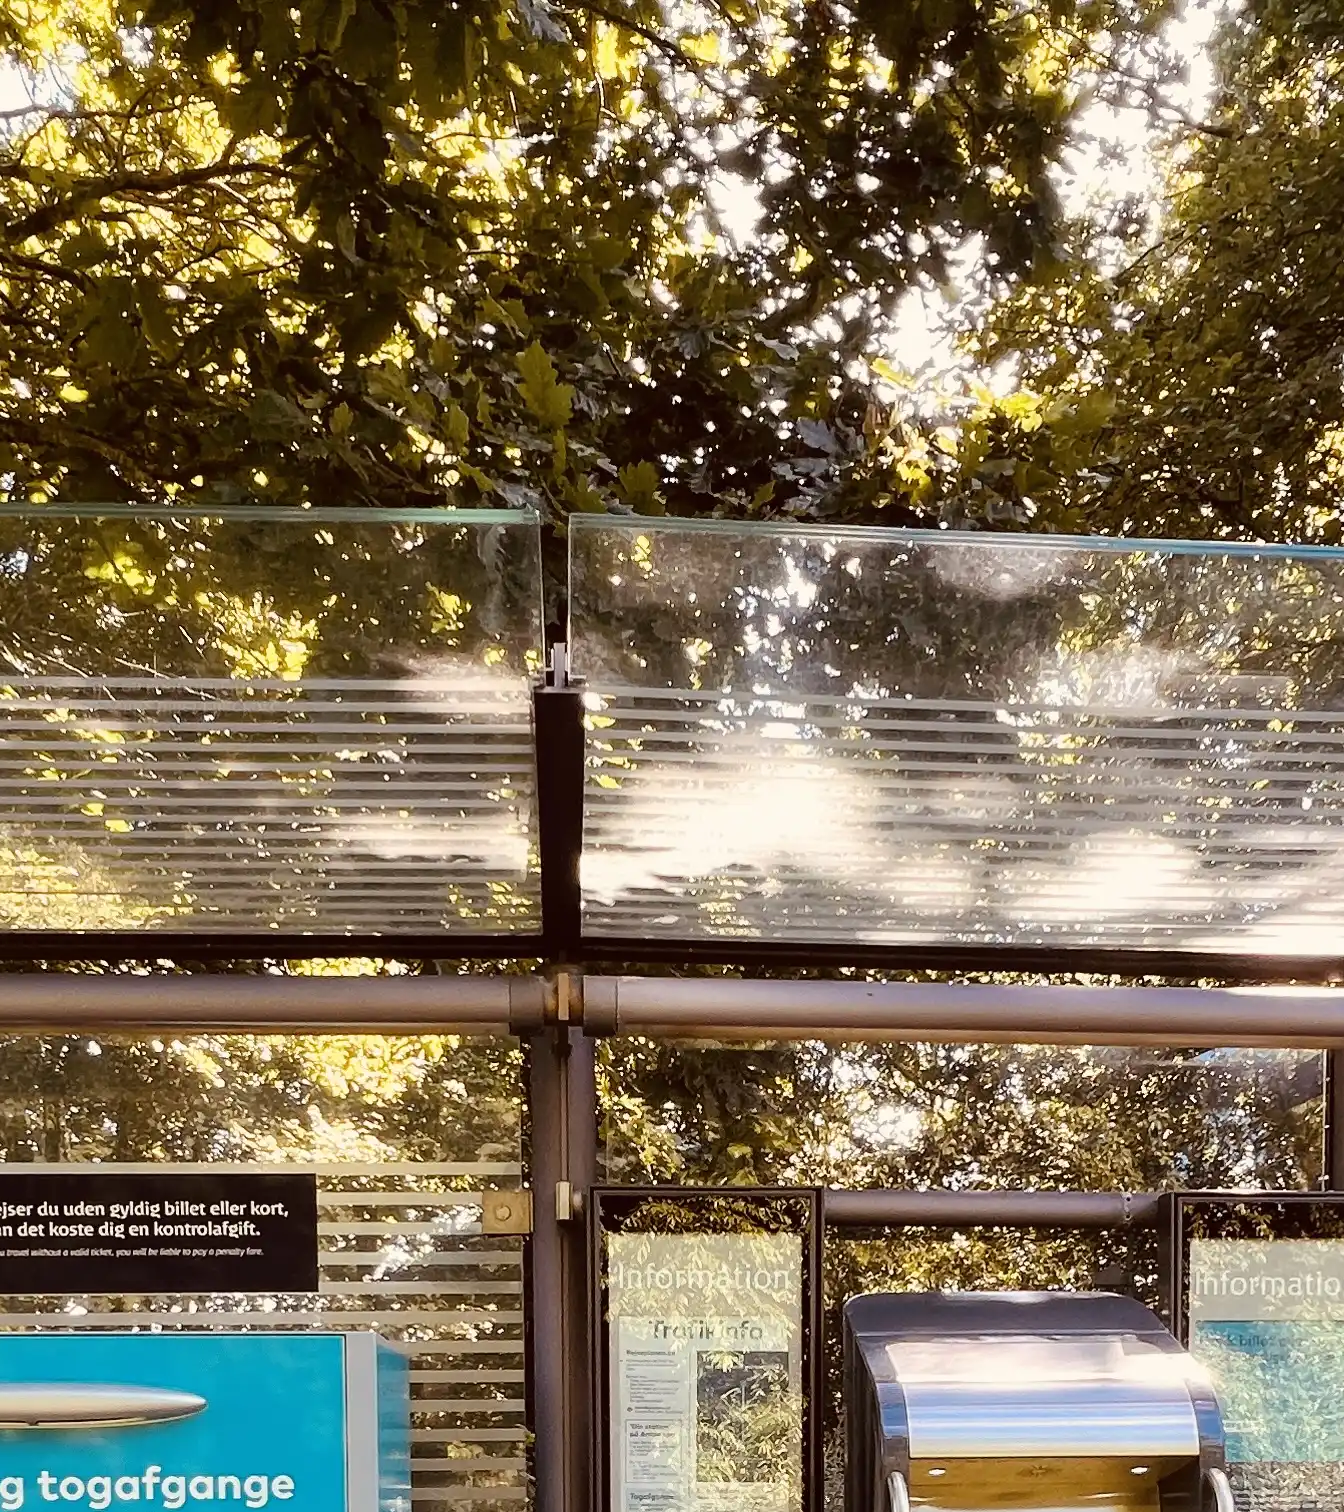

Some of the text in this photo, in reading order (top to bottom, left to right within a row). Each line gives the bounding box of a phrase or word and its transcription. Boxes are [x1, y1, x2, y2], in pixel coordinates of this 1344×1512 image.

[37, 1201, 59, 1216] du
[63, 1201, 105, 1216] uden
[109, 1201, 161, 1219] gyldig
[164, 1200, 206, 1216] billet
[209, 1200, 247, 1216] eller
[250, 1200, 288, 1217] kort,
[17, 1221, 45, 1237] det
[49, 1221, 94, 1237] koste
[98, 1221, 125, 1239] dig
[128, 1224, 149, 1236] en
[153, 1221, 260, 1238] kontrolafgift.
[116, 1250, 131, 1258] you
[148, 1248, 158, 1256] be
[618, 1262, 790, 1289] Information
[37, 1466, 296, 1509] togafgange
